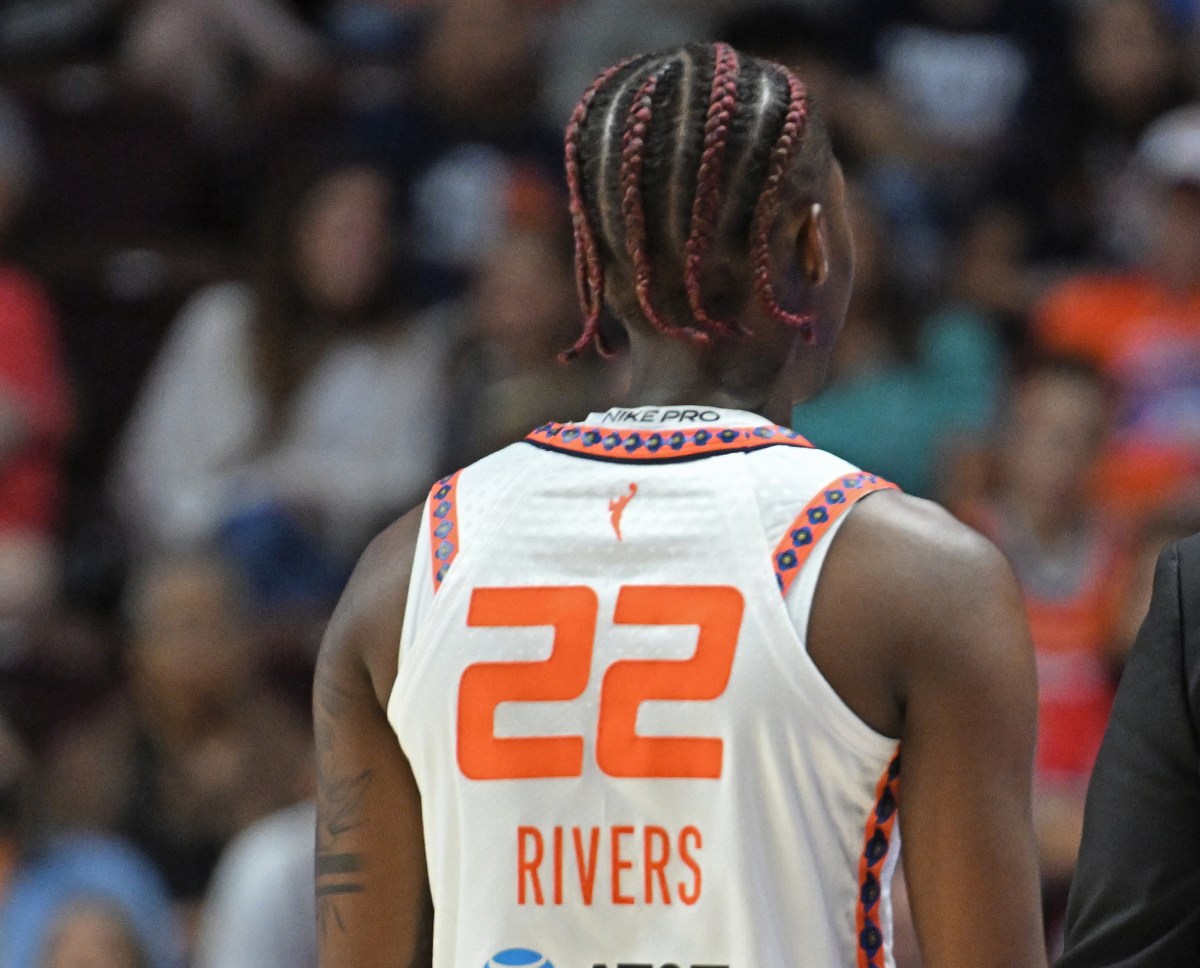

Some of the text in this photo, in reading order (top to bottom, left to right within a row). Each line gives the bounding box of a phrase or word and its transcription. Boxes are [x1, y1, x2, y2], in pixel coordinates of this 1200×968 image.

[602, 410, 721, 424] NIKE PRO
[456, 585, 746, 781] 22
[516, 825, 703, 906] RIVERS
